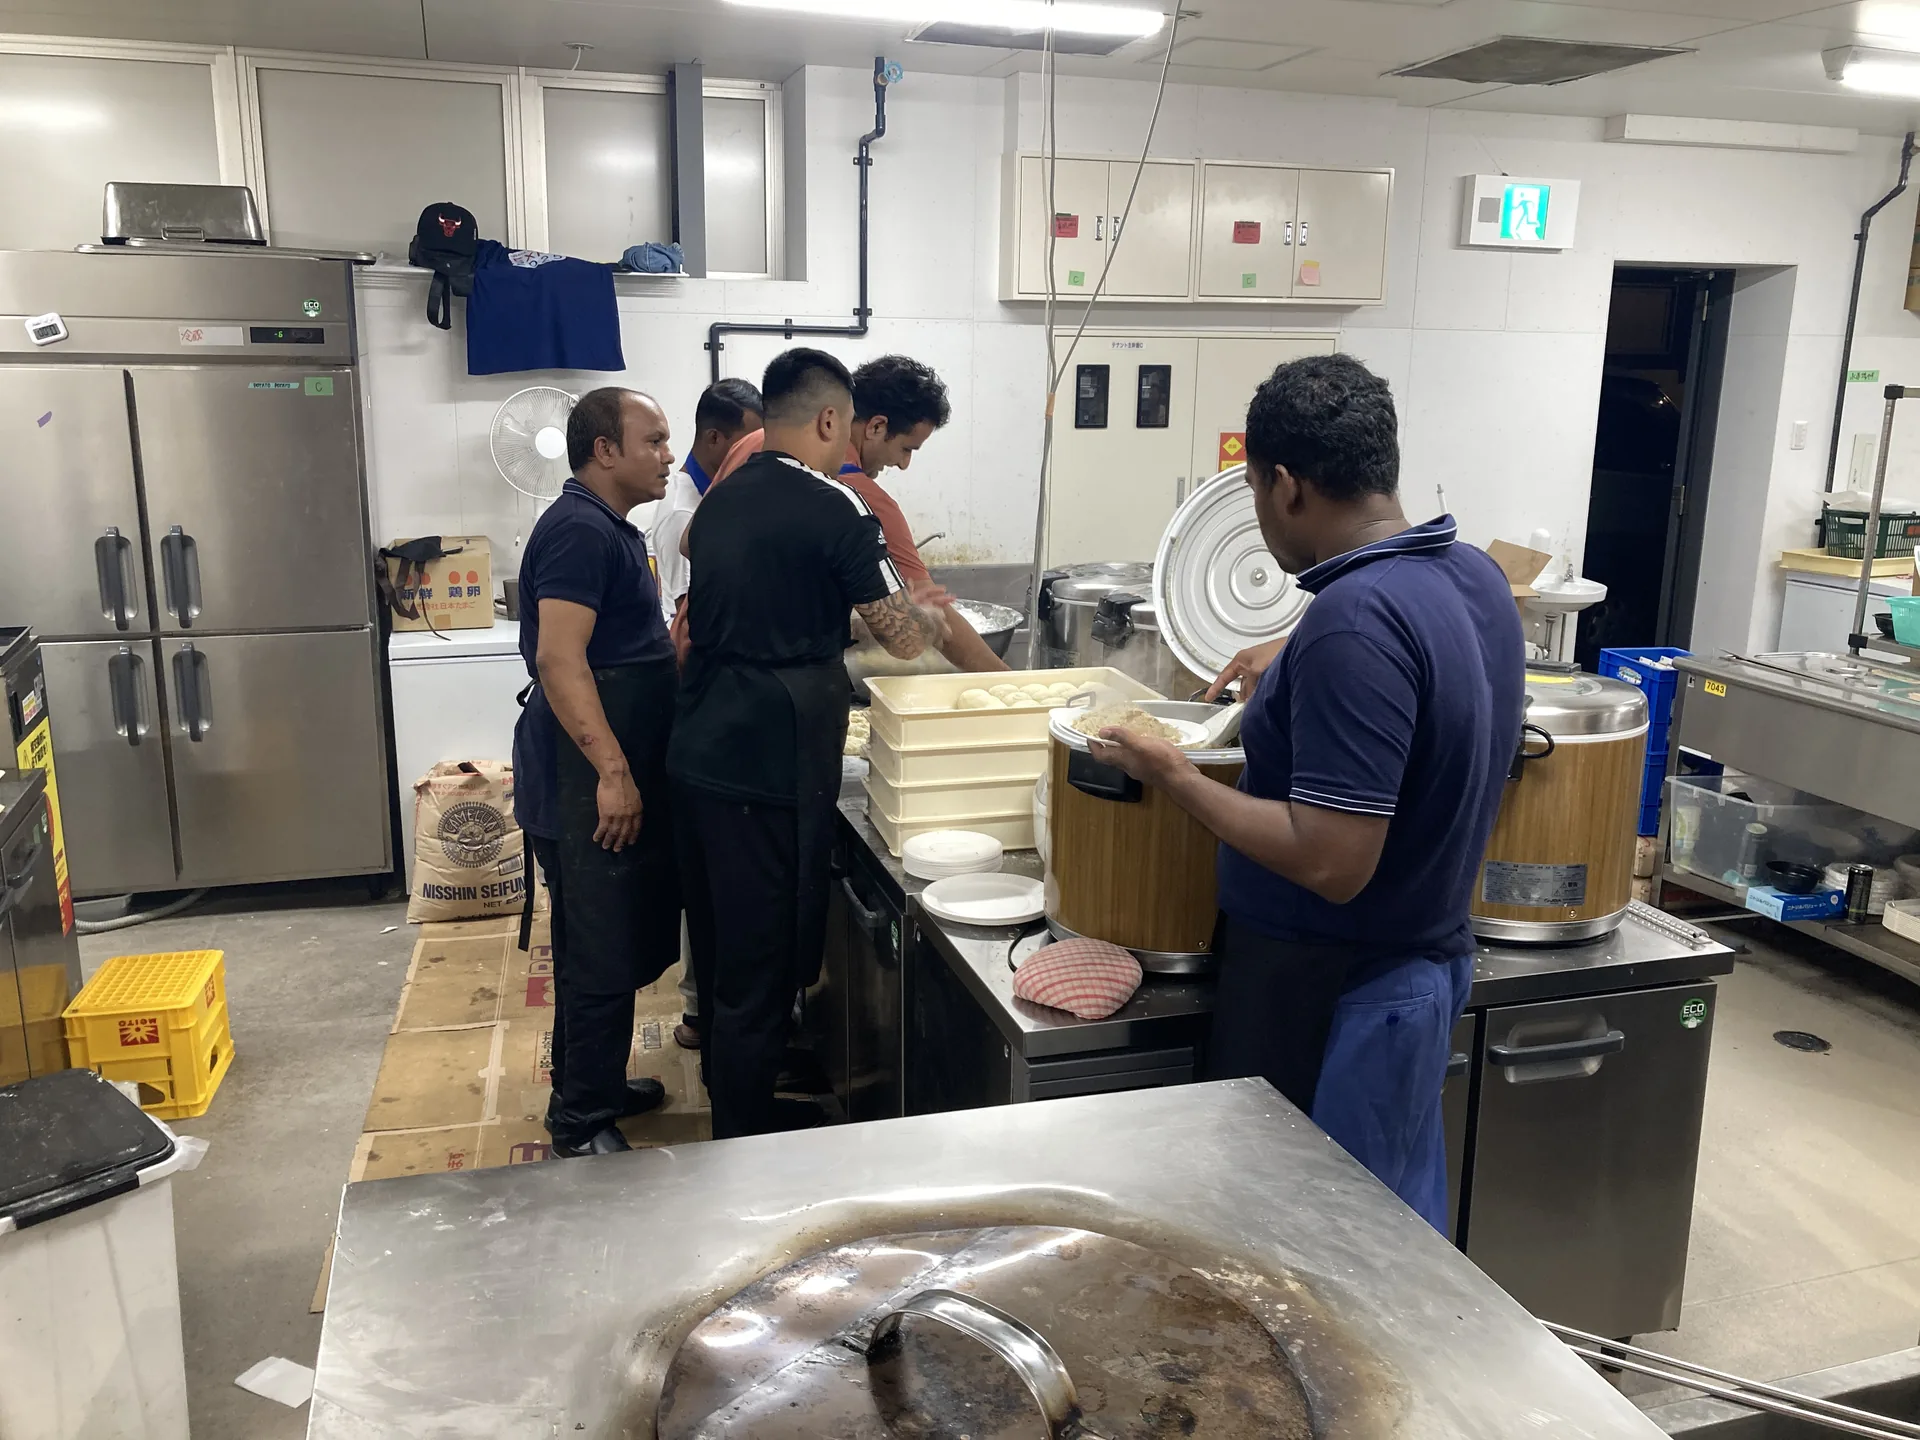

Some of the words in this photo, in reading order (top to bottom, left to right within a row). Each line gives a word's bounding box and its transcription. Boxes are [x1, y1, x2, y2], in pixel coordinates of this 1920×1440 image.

[303, 301, 320, 309] ECO
[409, 602, 476, 611] 会社日本たまご
[1706, 681, 1725, 694] 7043
[444, 808, 499, 833] CAMELLIA
[422, 882, 478, 900] NISSHIN
[481, 876, 526, 898] SEIFUN
[483, 901, 502, 909] NET
[1683, 1003, 1705, 1014] ECO
